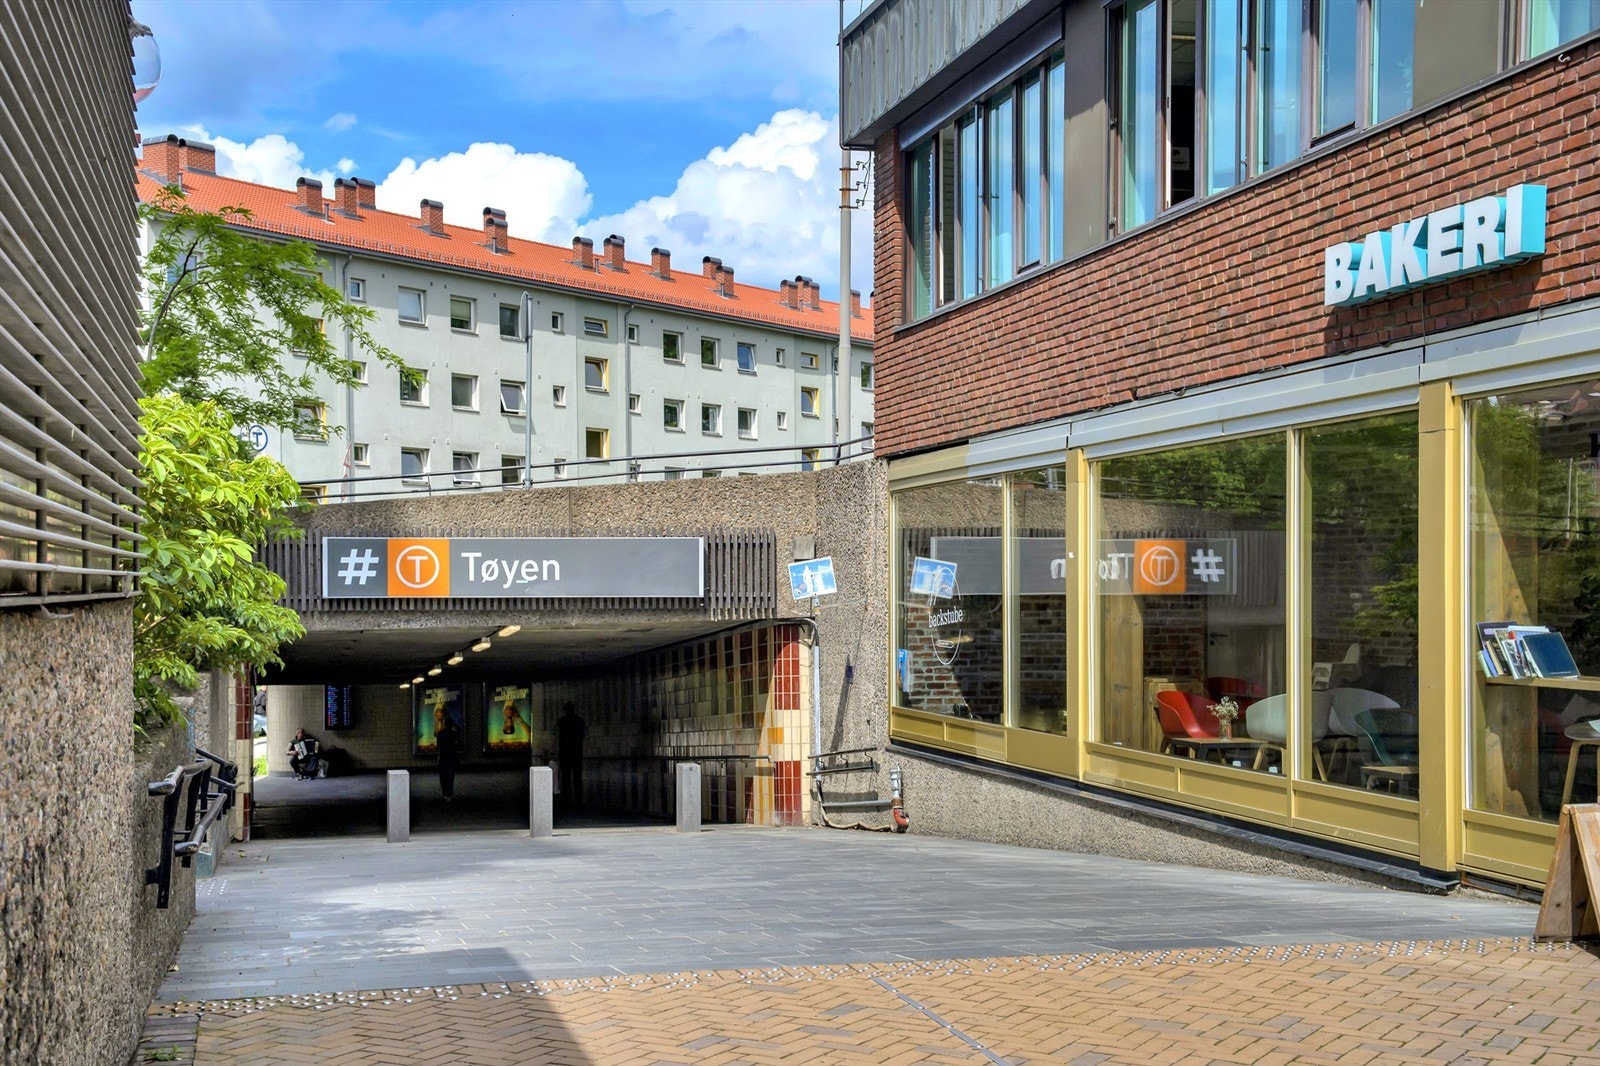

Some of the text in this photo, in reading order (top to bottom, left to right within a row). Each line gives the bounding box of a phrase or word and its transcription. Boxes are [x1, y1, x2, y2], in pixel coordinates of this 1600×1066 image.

[1325, 184, 1546, 306] BAKERI
[461, 552, 560, 588] Tøyen
[928, 605, 963, 628] backstube
